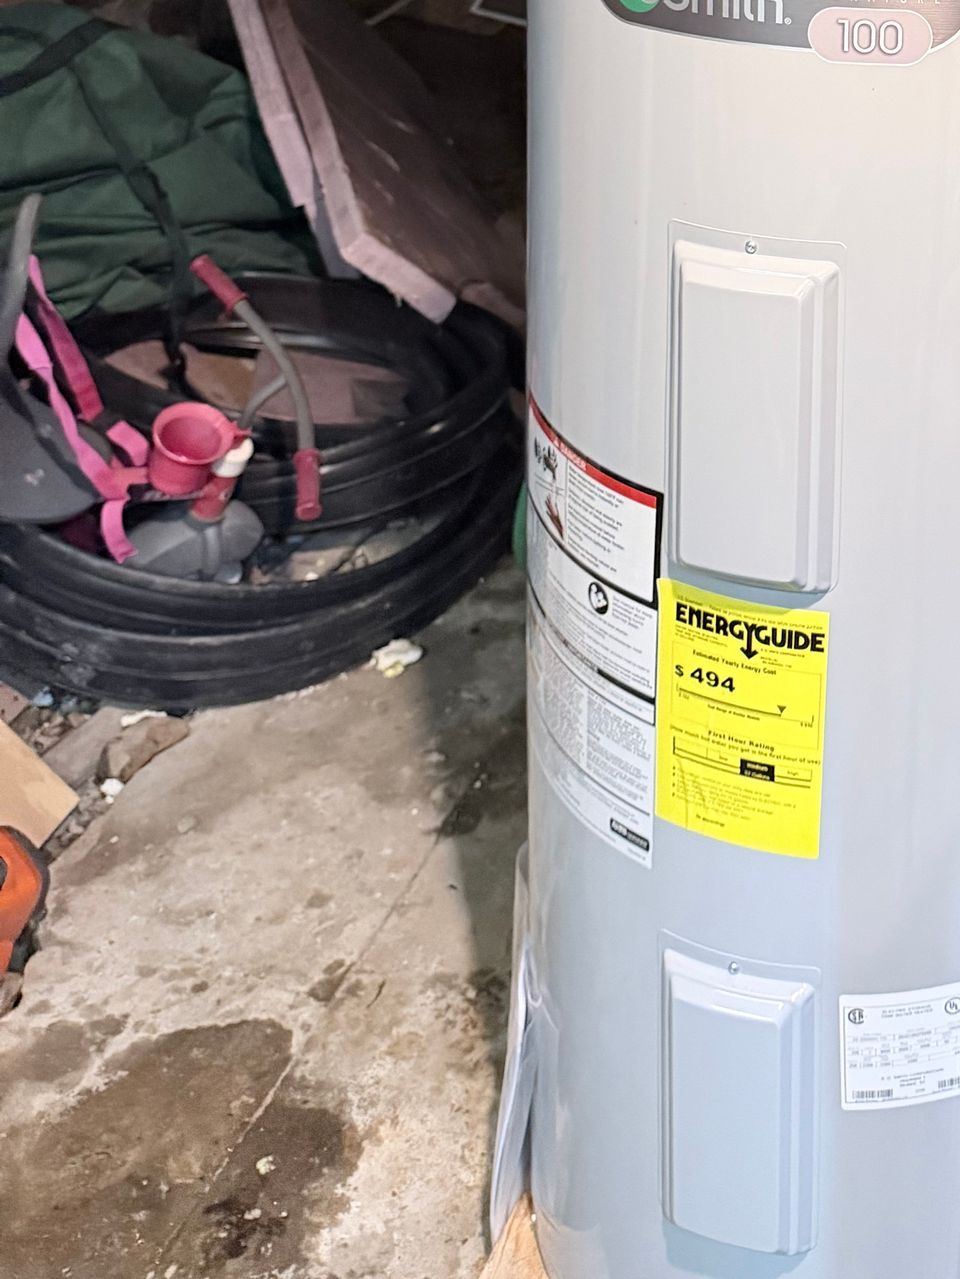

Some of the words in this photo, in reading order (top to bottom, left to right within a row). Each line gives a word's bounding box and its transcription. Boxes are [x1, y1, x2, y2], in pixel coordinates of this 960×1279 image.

[837, 18, 905, 55] 100
[676, 601, 825, 659] ENERGYGUIDE
[690, 667, 736, 692] 494
[708, 729, 726, 740] First
[728, 734, 746, 745] Hour
[749, 739, 775, 752] Rating
